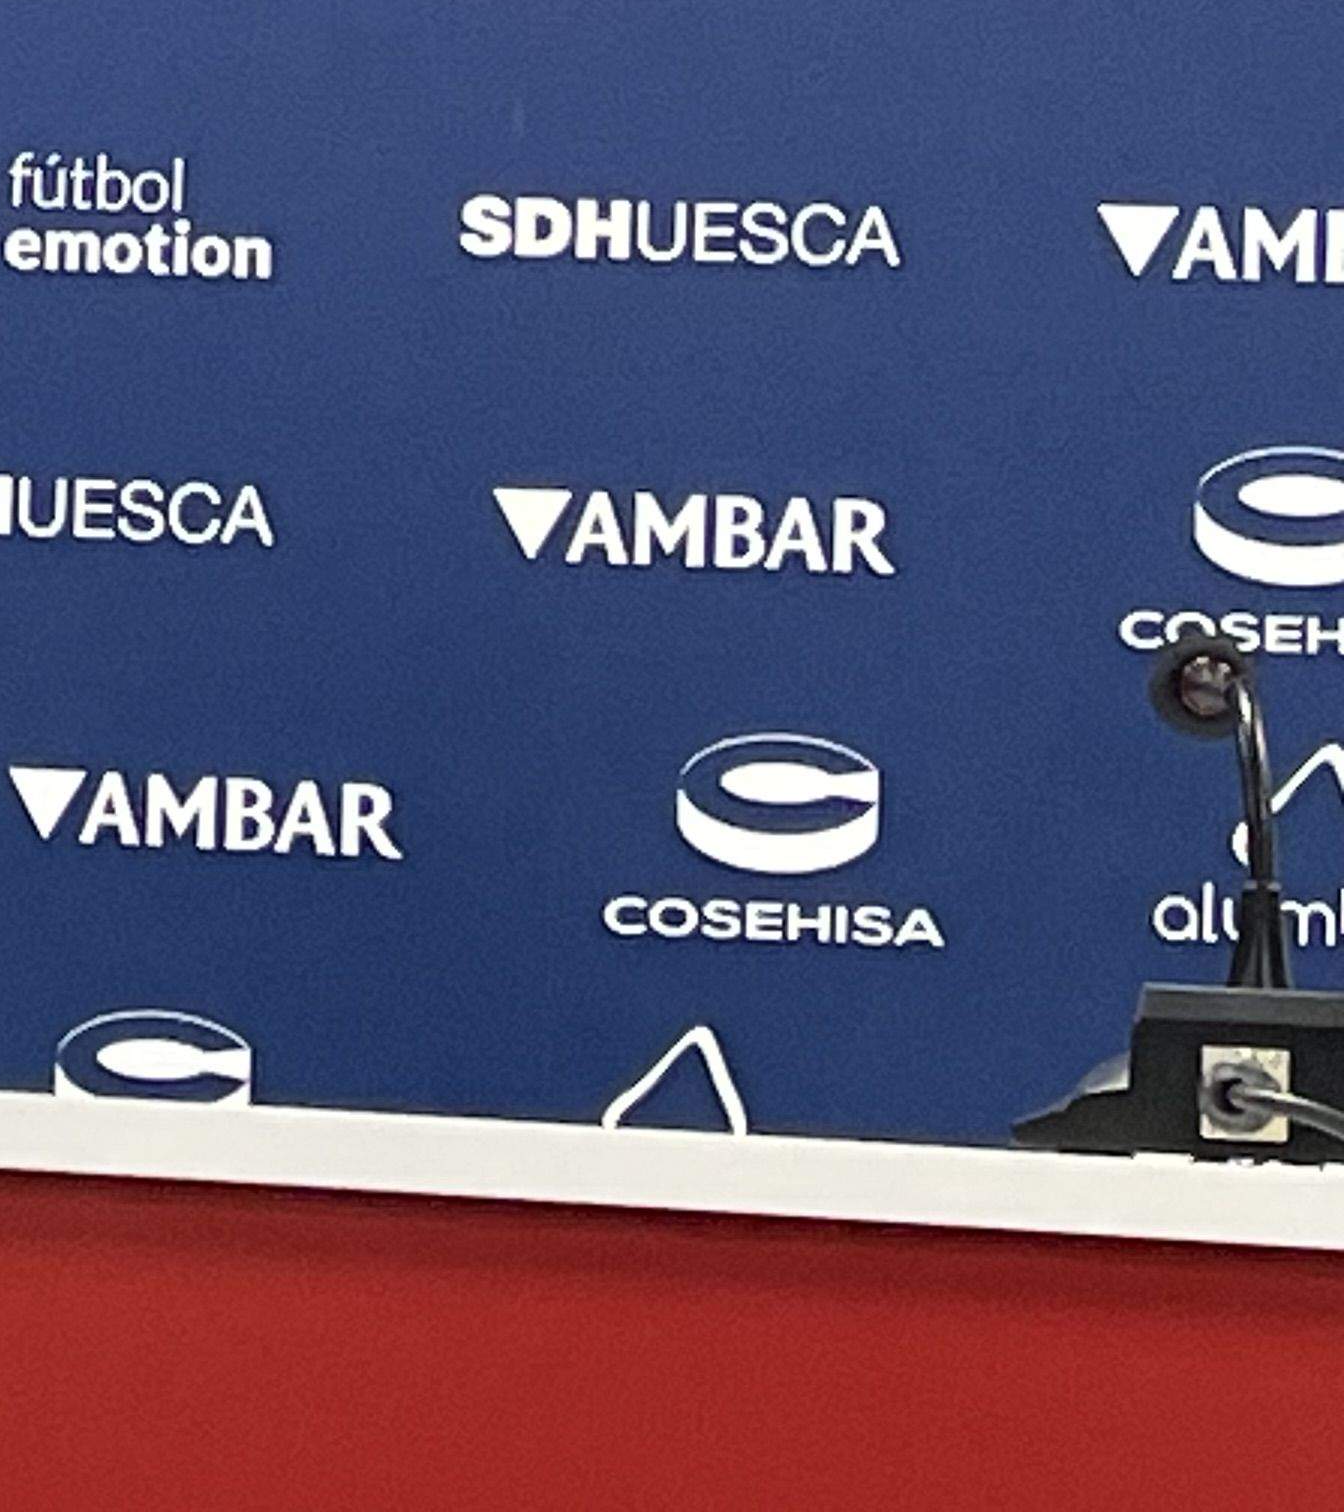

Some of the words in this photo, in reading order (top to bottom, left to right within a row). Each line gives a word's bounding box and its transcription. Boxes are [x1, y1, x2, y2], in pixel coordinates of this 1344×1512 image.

[8, 151, 185, 213] fútbol
[4, 220, 272, 279] emotion
[459, 194, 901, 267] SDHUESCA
[565, 491, 896, 575] AMBAR
[79, 772, 403, 859] AMBAR
[603, 896, 945, 947] COSEHISA
